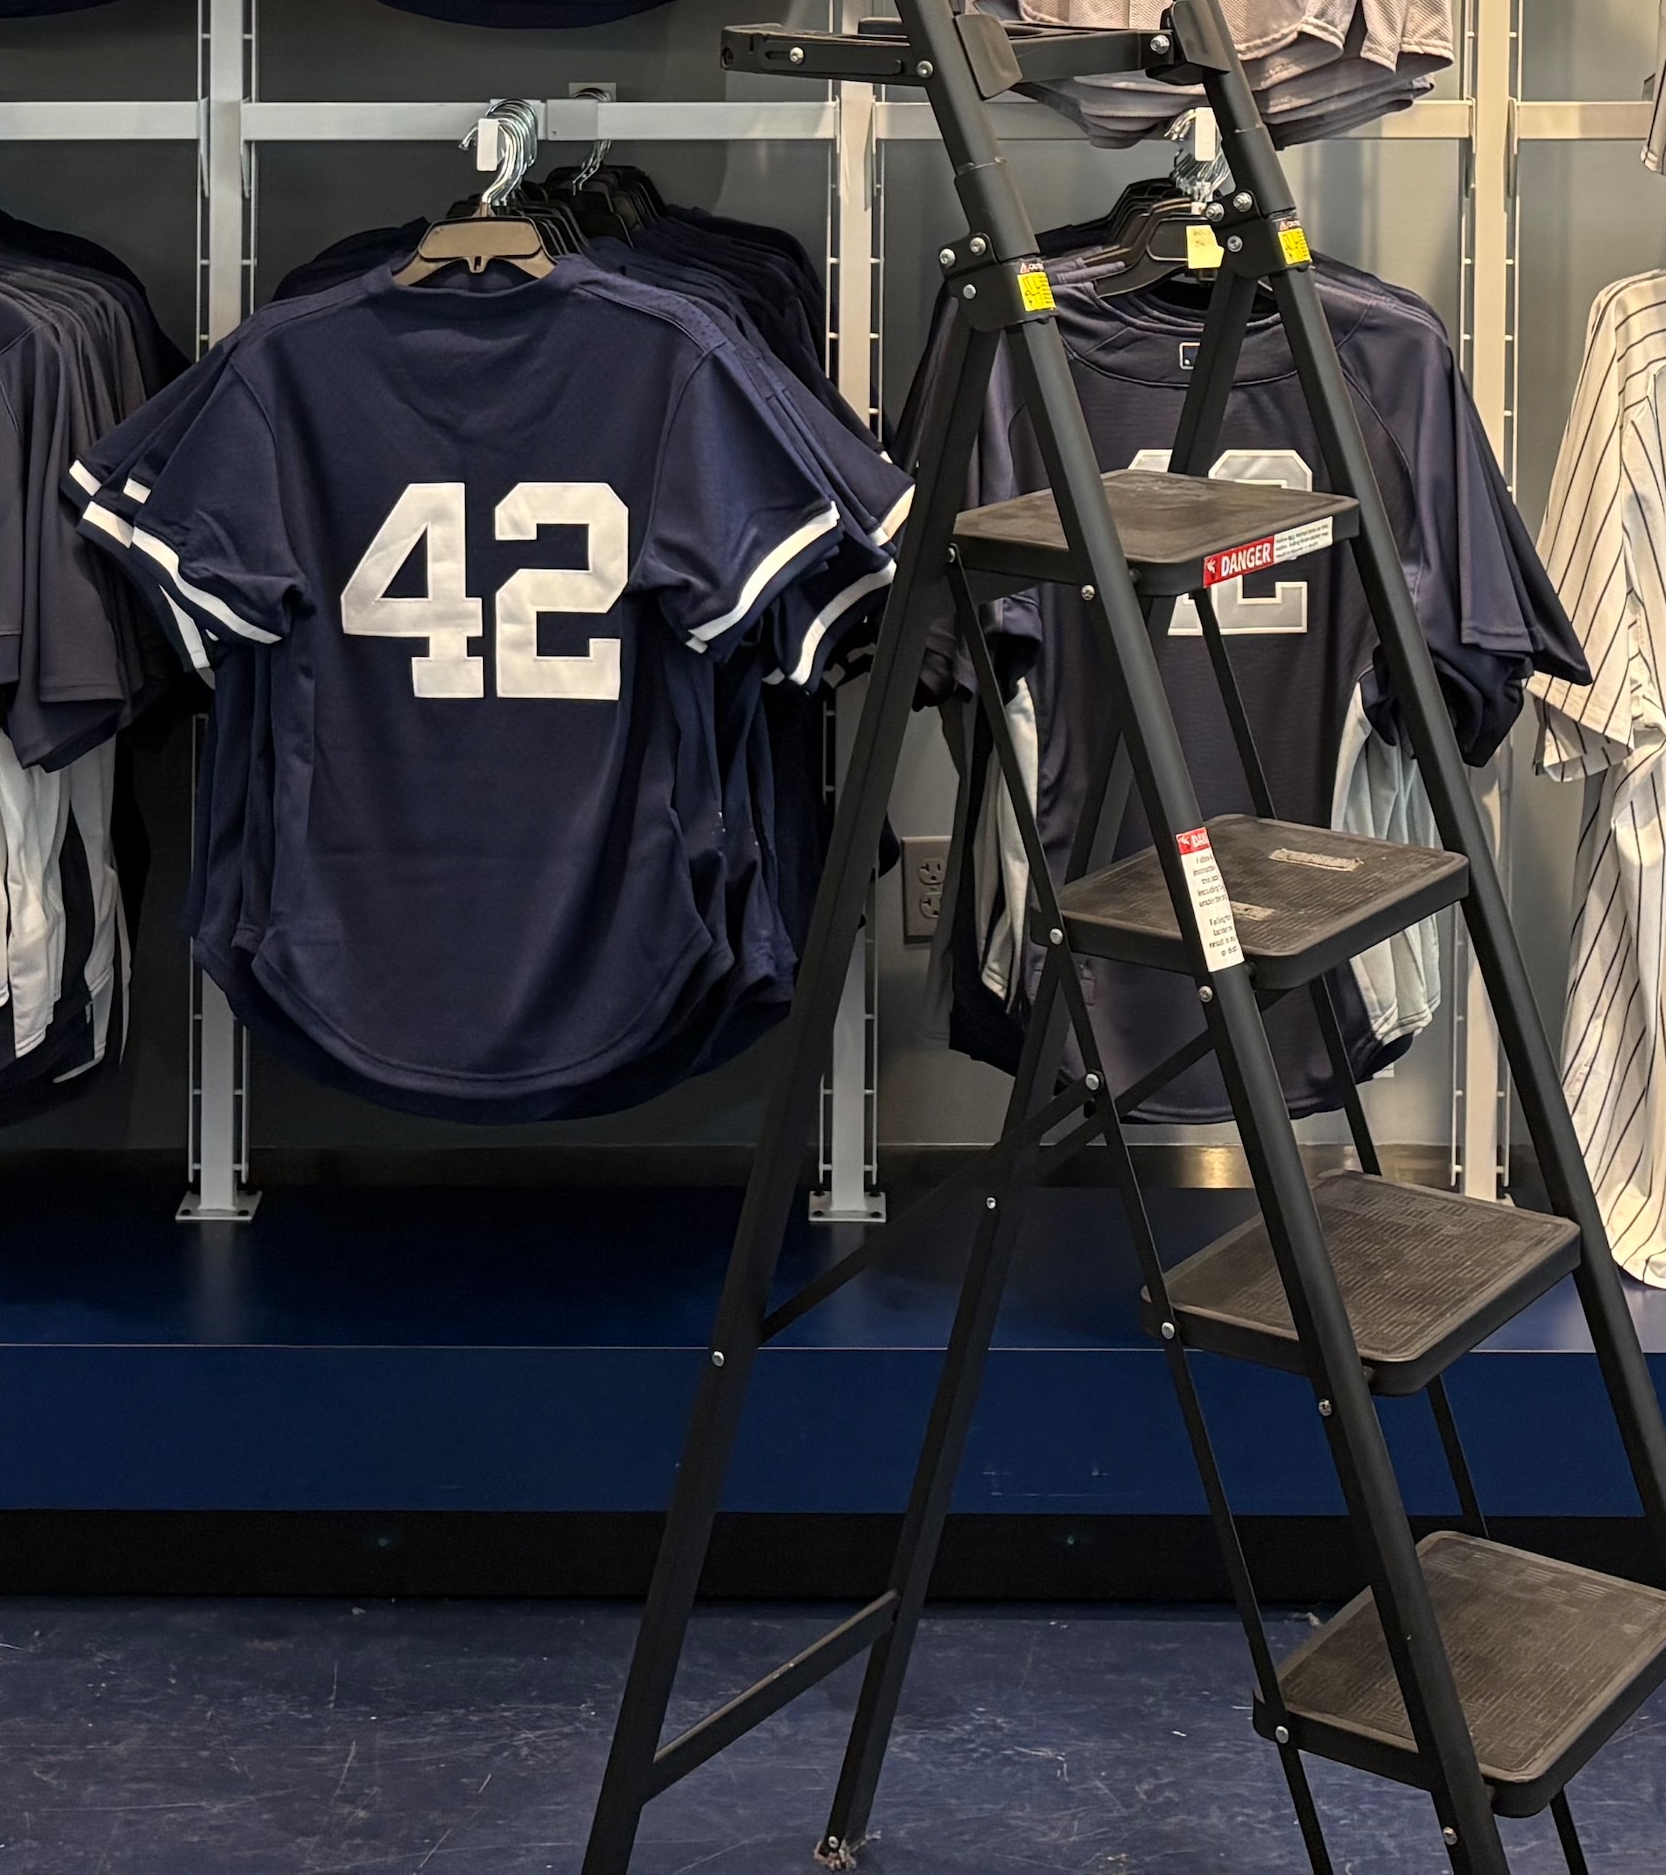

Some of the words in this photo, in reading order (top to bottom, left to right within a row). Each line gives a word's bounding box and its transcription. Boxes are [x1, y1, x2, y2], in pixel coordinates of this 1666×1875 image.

[340, 482, 629, 700] 42
[1128, 449, 1313, 638] 2
[1221, 543, 1272, 577] DANGER
